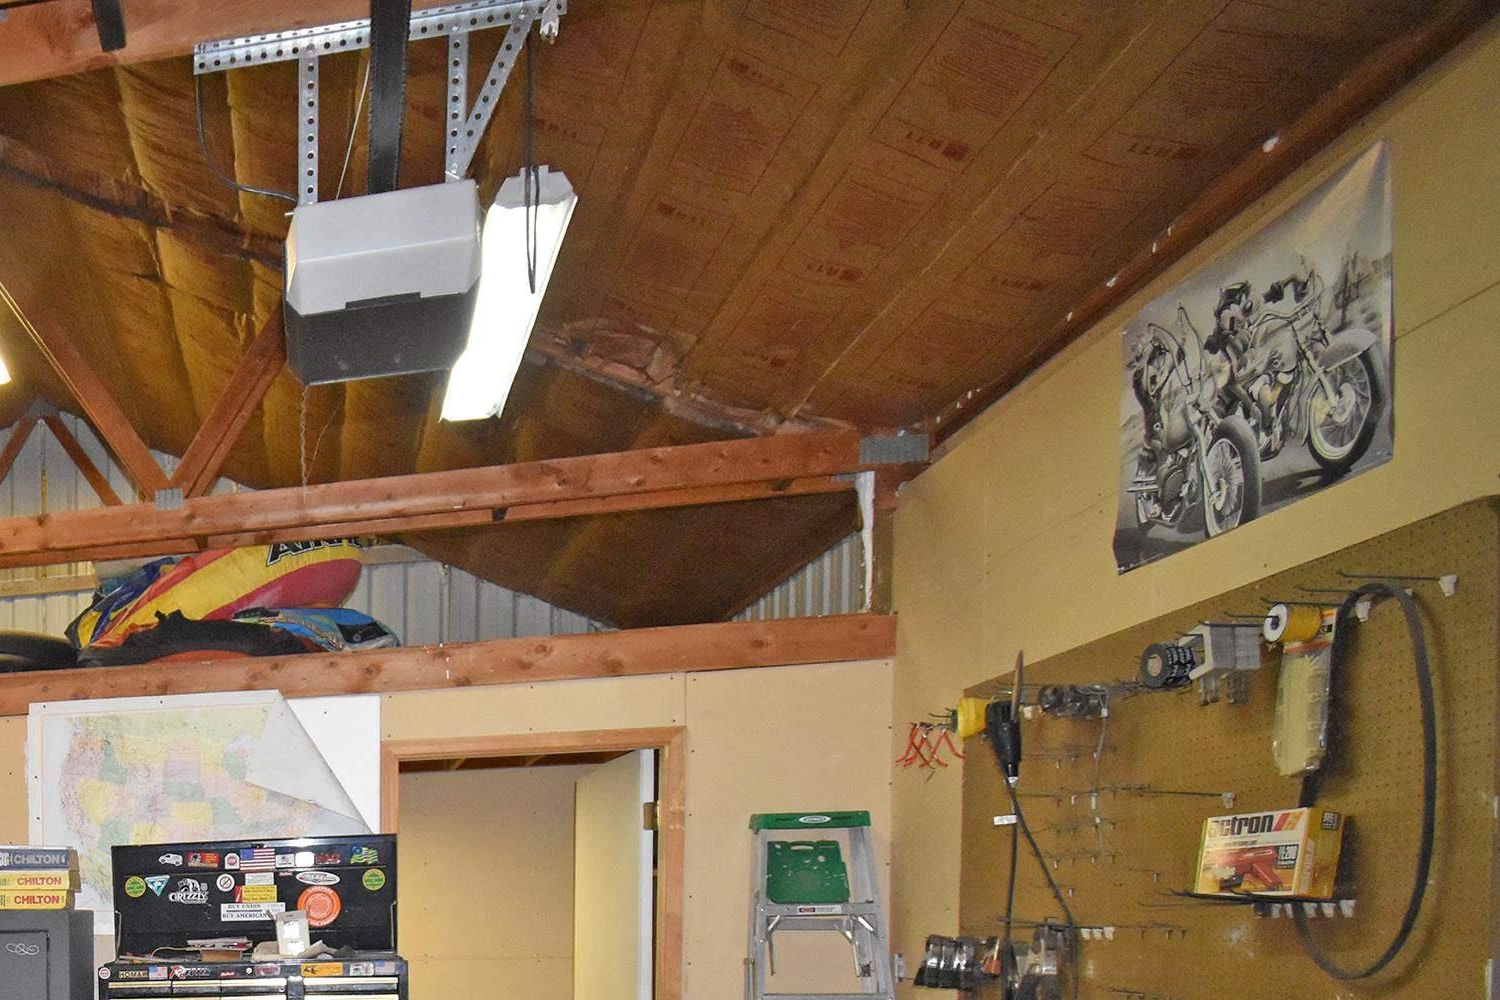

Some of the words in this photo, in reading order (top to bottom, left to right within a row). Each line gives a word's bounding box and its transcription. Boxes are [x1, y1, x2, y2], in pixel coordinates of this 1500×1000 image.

[13, 854, 60, 865] CHILTON
[16, 876, 62, 886] CHILTON
[13, 895, 60, 905] CHILTON
